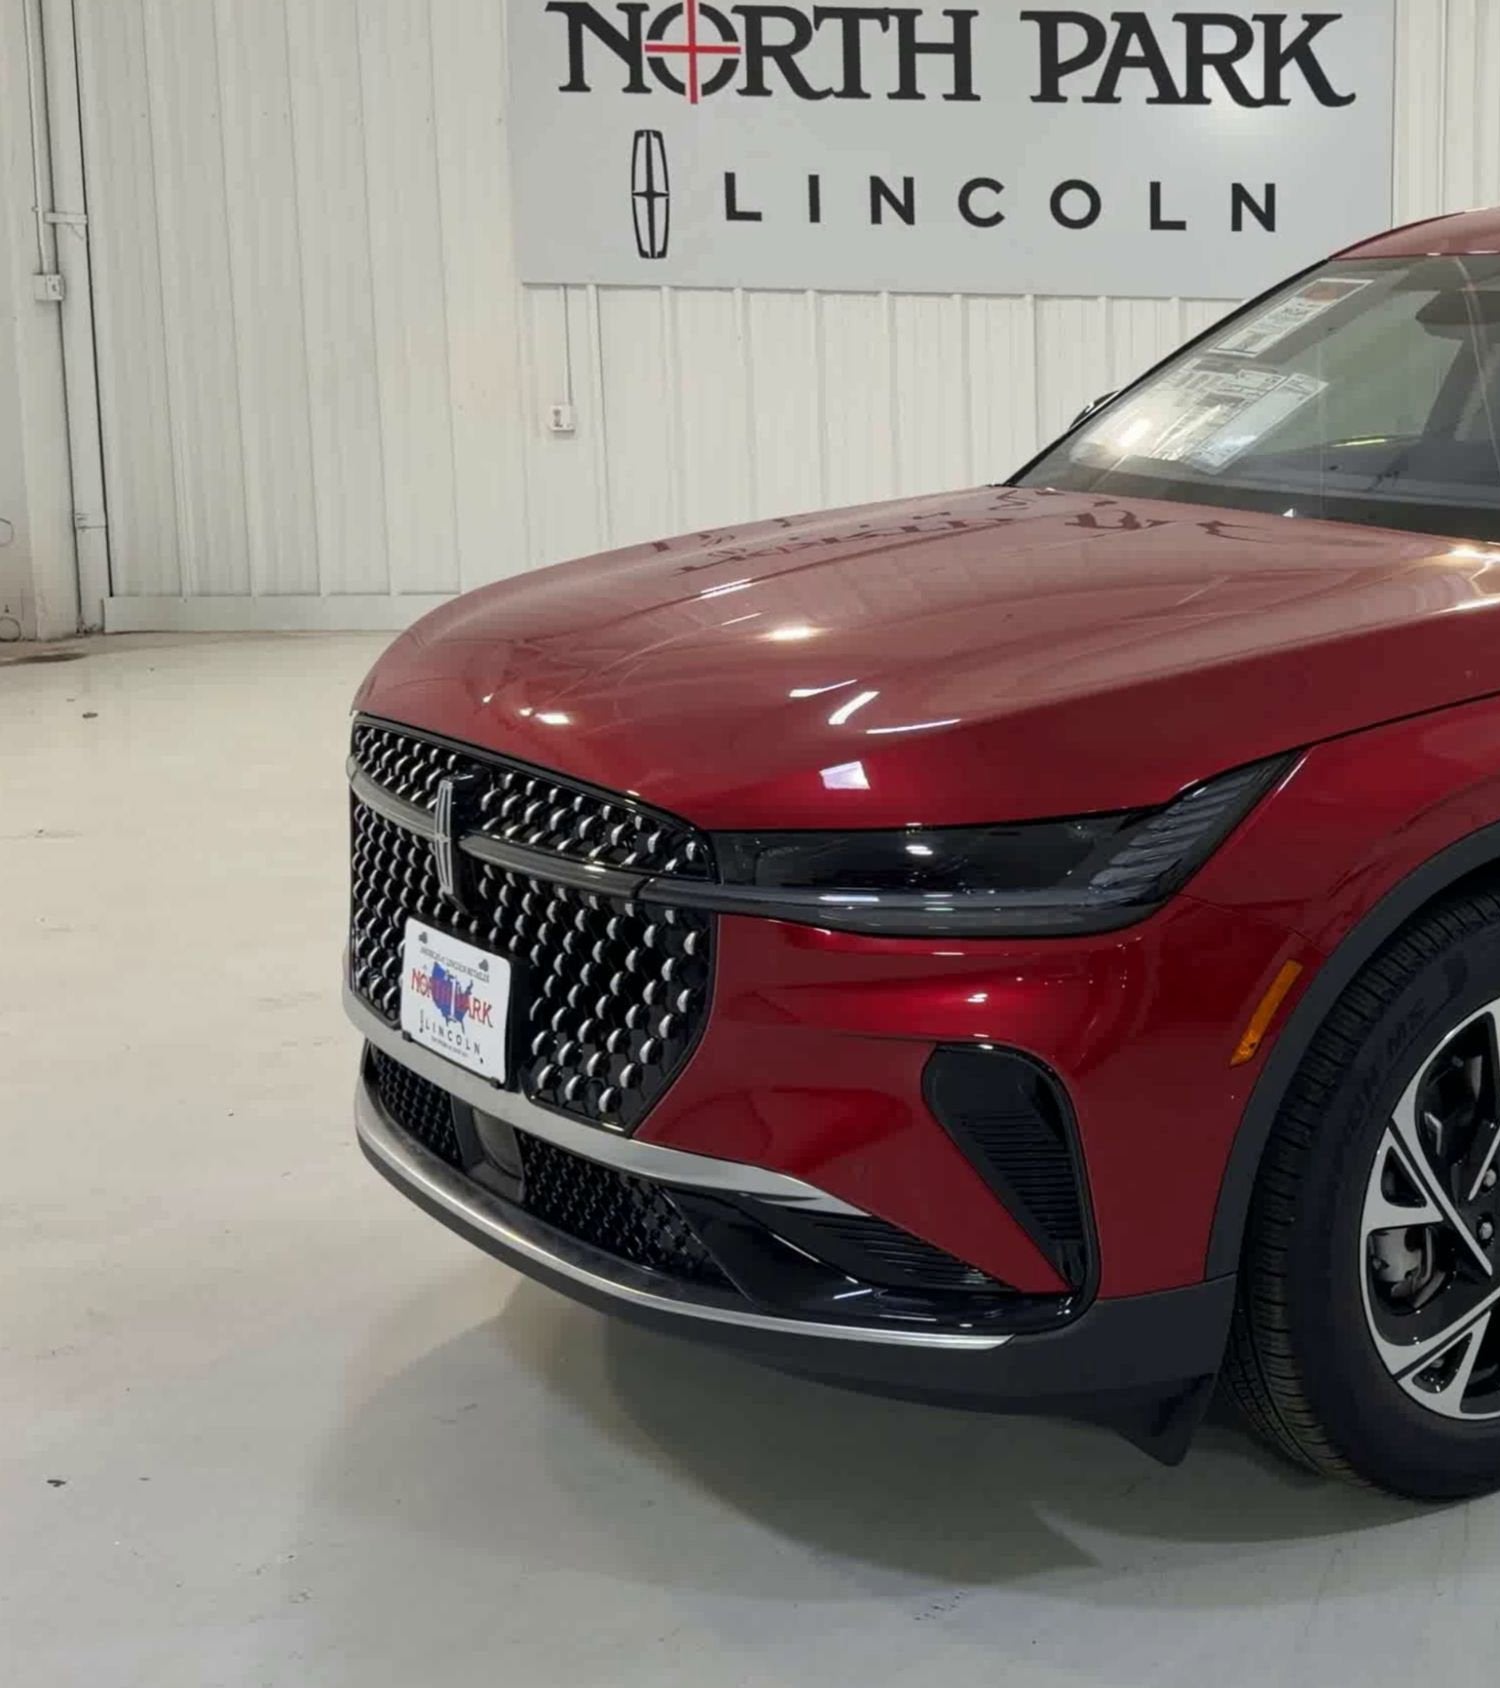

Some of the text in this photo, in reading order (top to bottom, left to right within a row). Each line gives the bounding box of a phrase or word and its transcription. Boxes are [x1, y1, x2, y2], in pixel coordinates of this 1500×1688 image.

[545, 1, 1356, 109] NORTH PARK
[723, 172, 1277, 232] LINCOLN
[425, 1018, 480, 1055] LINCOLN
